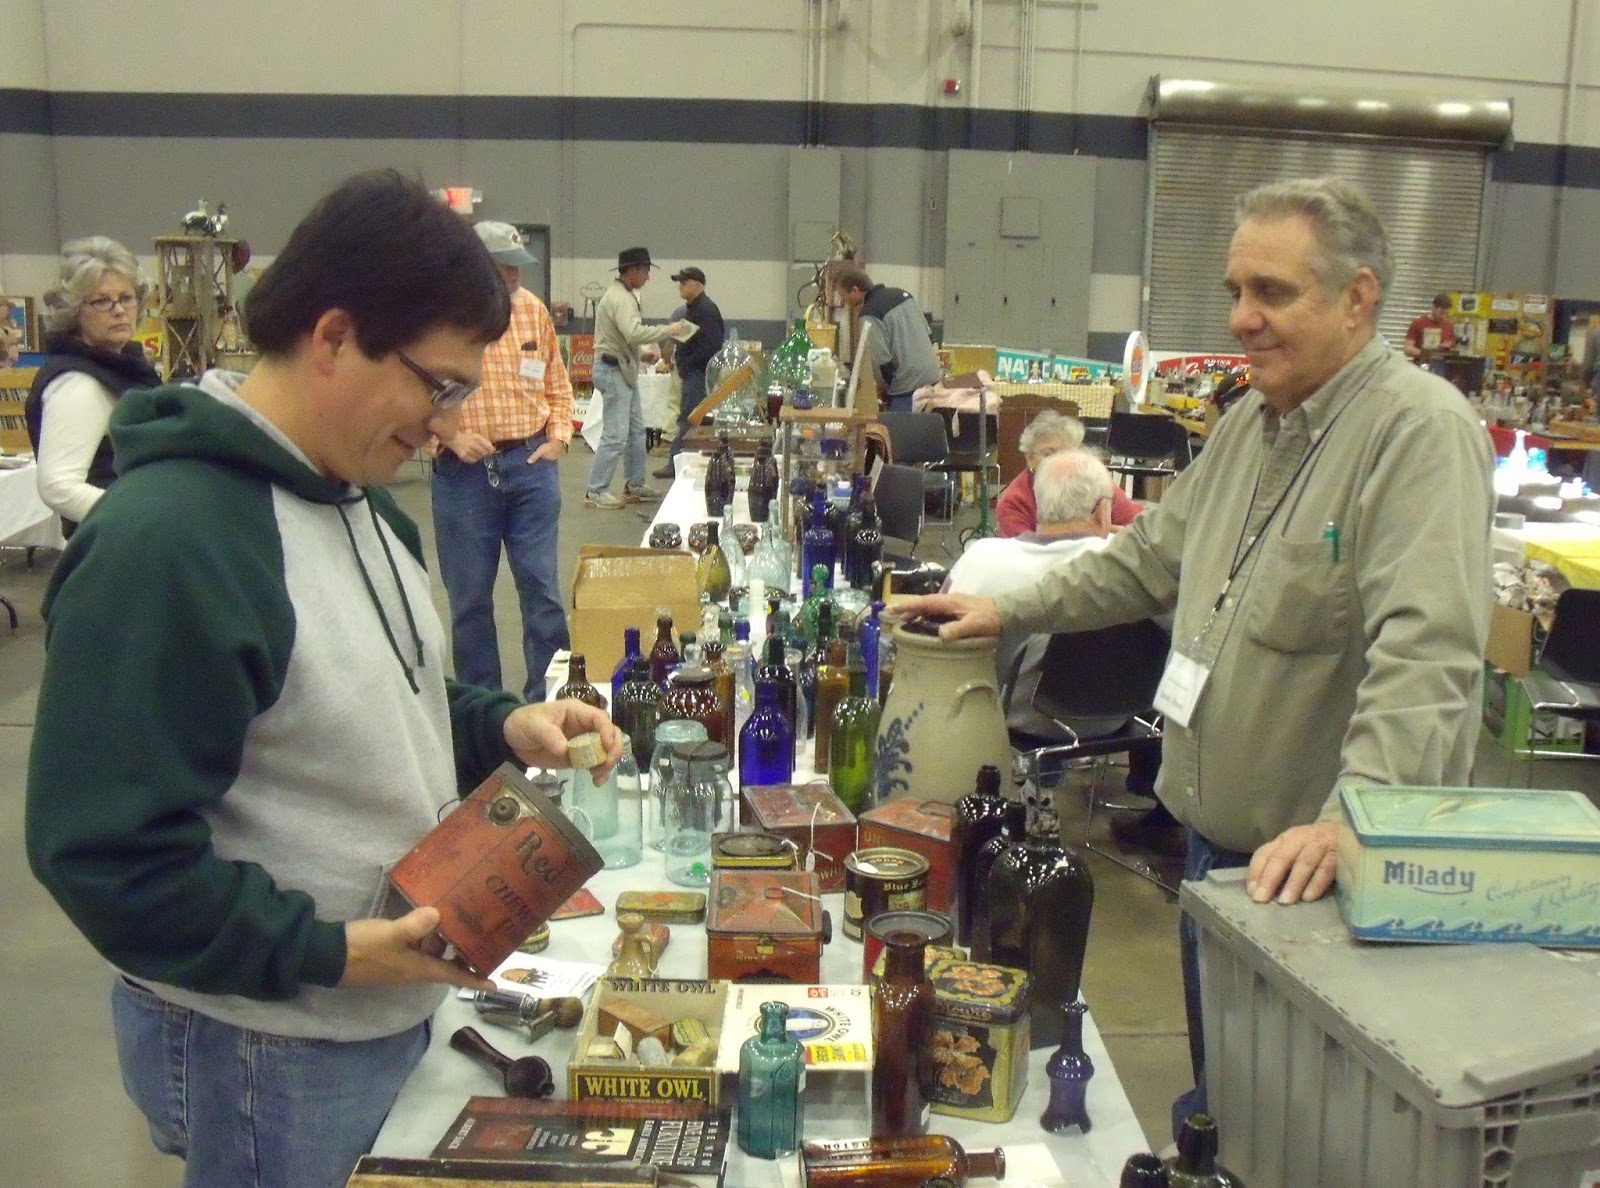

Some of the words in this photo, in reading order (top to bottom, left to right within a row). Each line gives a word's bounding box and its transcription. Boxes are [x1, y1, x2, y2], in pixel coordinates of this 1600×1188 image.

[1383, 860, 1476, 893] Milady
[612, 981, 670, 993] WHITE
[676, 983, 716, 995] OWL
[825, 1006, 852, 1027] WHITE
[824, 1027, 850, 1042] OWL
[585, 1077, 651, 1098] WHITE
[657, 1078, 704, 1099] OWL
[706, 1120, 719, 1141] THE
[649, 1120, 684, 1167] FURNITURE
[701, 1145, 714, 1167] NEW
